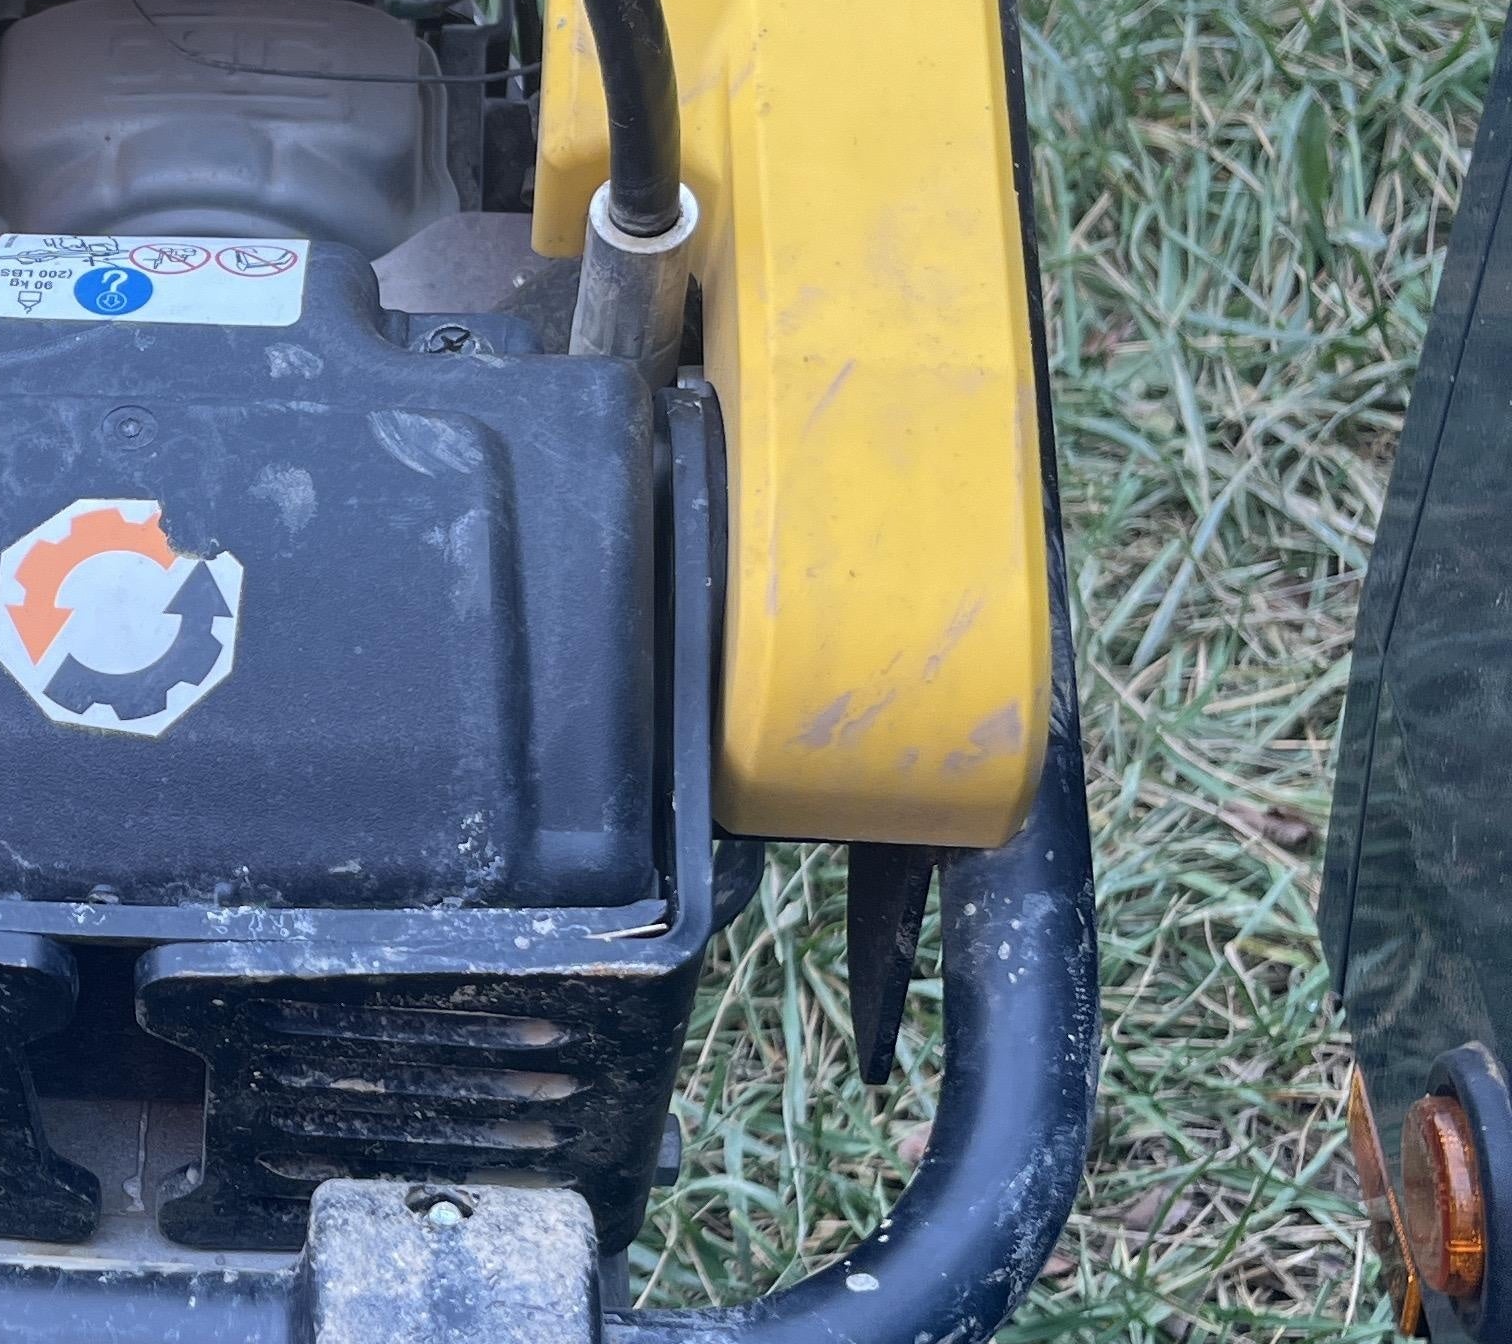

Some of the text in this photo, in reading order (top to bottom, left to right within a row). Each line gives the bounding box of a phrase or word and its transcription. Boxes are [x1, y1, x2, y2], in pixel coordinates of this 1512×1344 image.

[38, 268, 73, 279] (200
[9, 277, 53, 290] 90 kg
